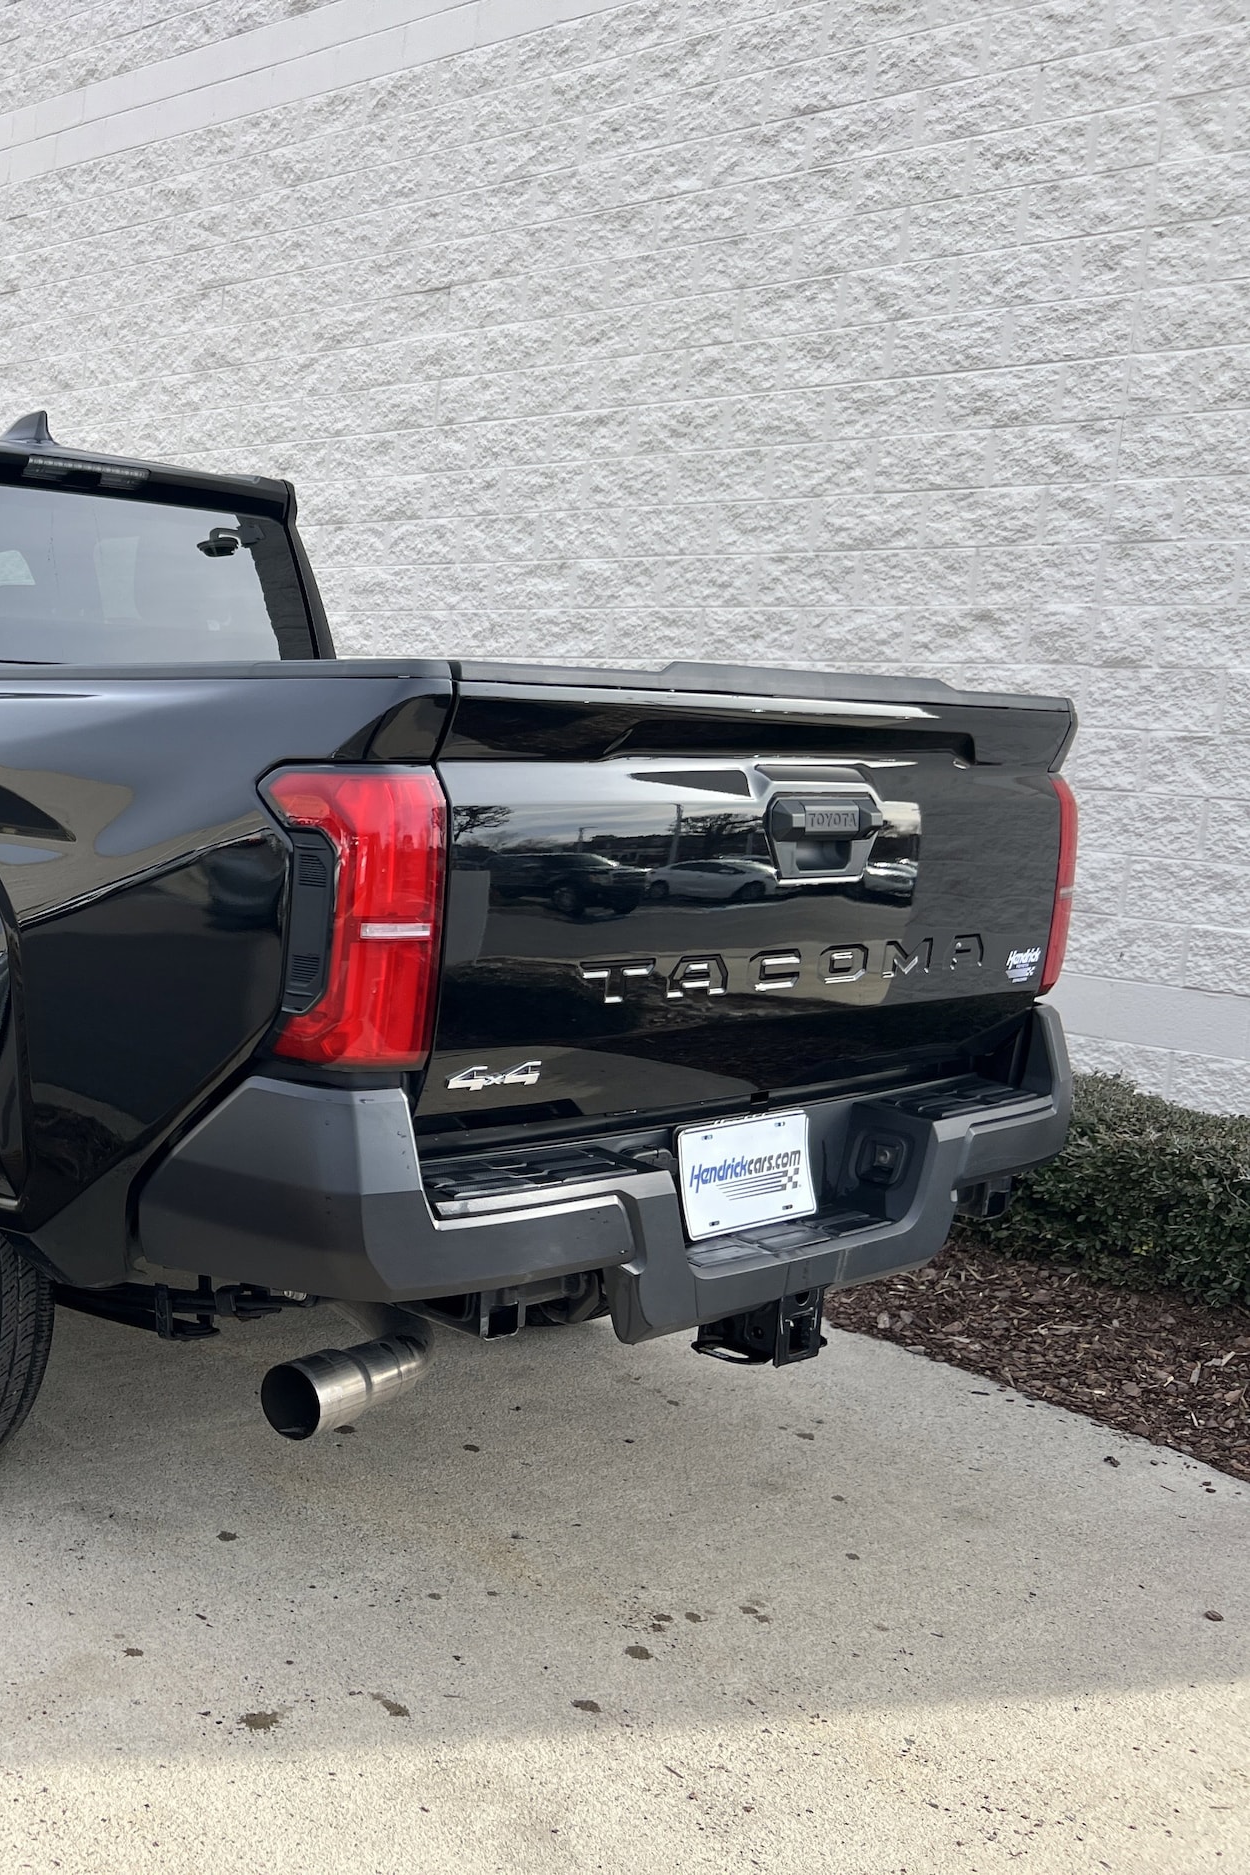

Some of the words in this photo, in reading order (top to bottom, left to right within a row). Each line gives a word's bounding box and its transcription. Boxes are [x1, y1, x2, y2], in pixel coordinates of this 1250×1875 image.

[808, 812, 857, 828] TOYOTA
[579, 934, 984, 1003] TACOMA
[445, 1060, 542, 1091] 4x4
[690, 1150, 801, 1193] Hendrickcars.com
